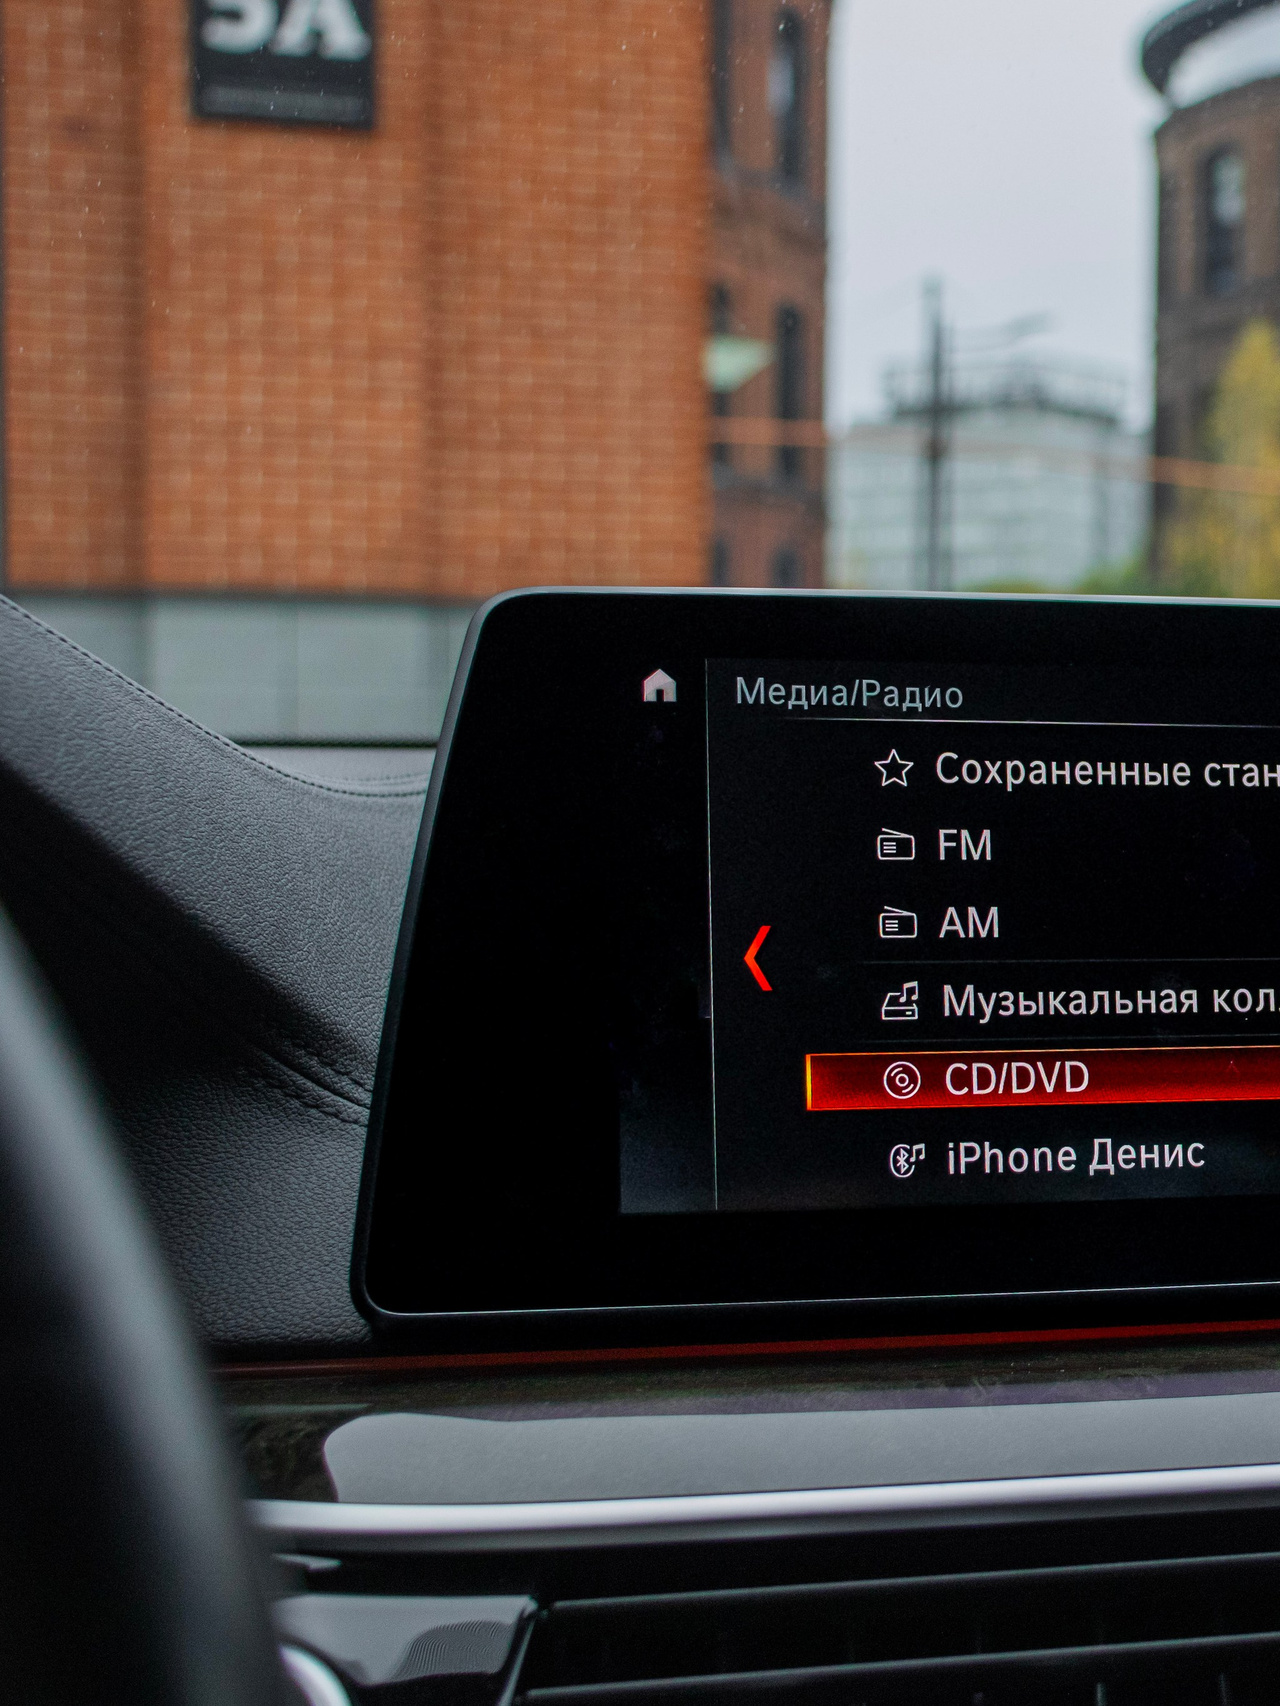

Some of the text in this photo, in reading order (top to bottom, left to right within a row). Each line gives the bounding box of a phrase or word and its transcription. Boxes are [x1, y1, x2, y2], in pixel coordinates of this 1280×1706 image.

[736, 676, 963, 712] Медиа/Радио
[936, 751, 1191, 791] Сохраненные
[938, 829, 992, 861] FM
[939, 906, 999, 939] AM
[943, 984, 1198, 1023] Музыкальная
[945, 1060, 1089, 1096] CD/DVD
[948, 1138, 1205, 1176] iPhone Денис
